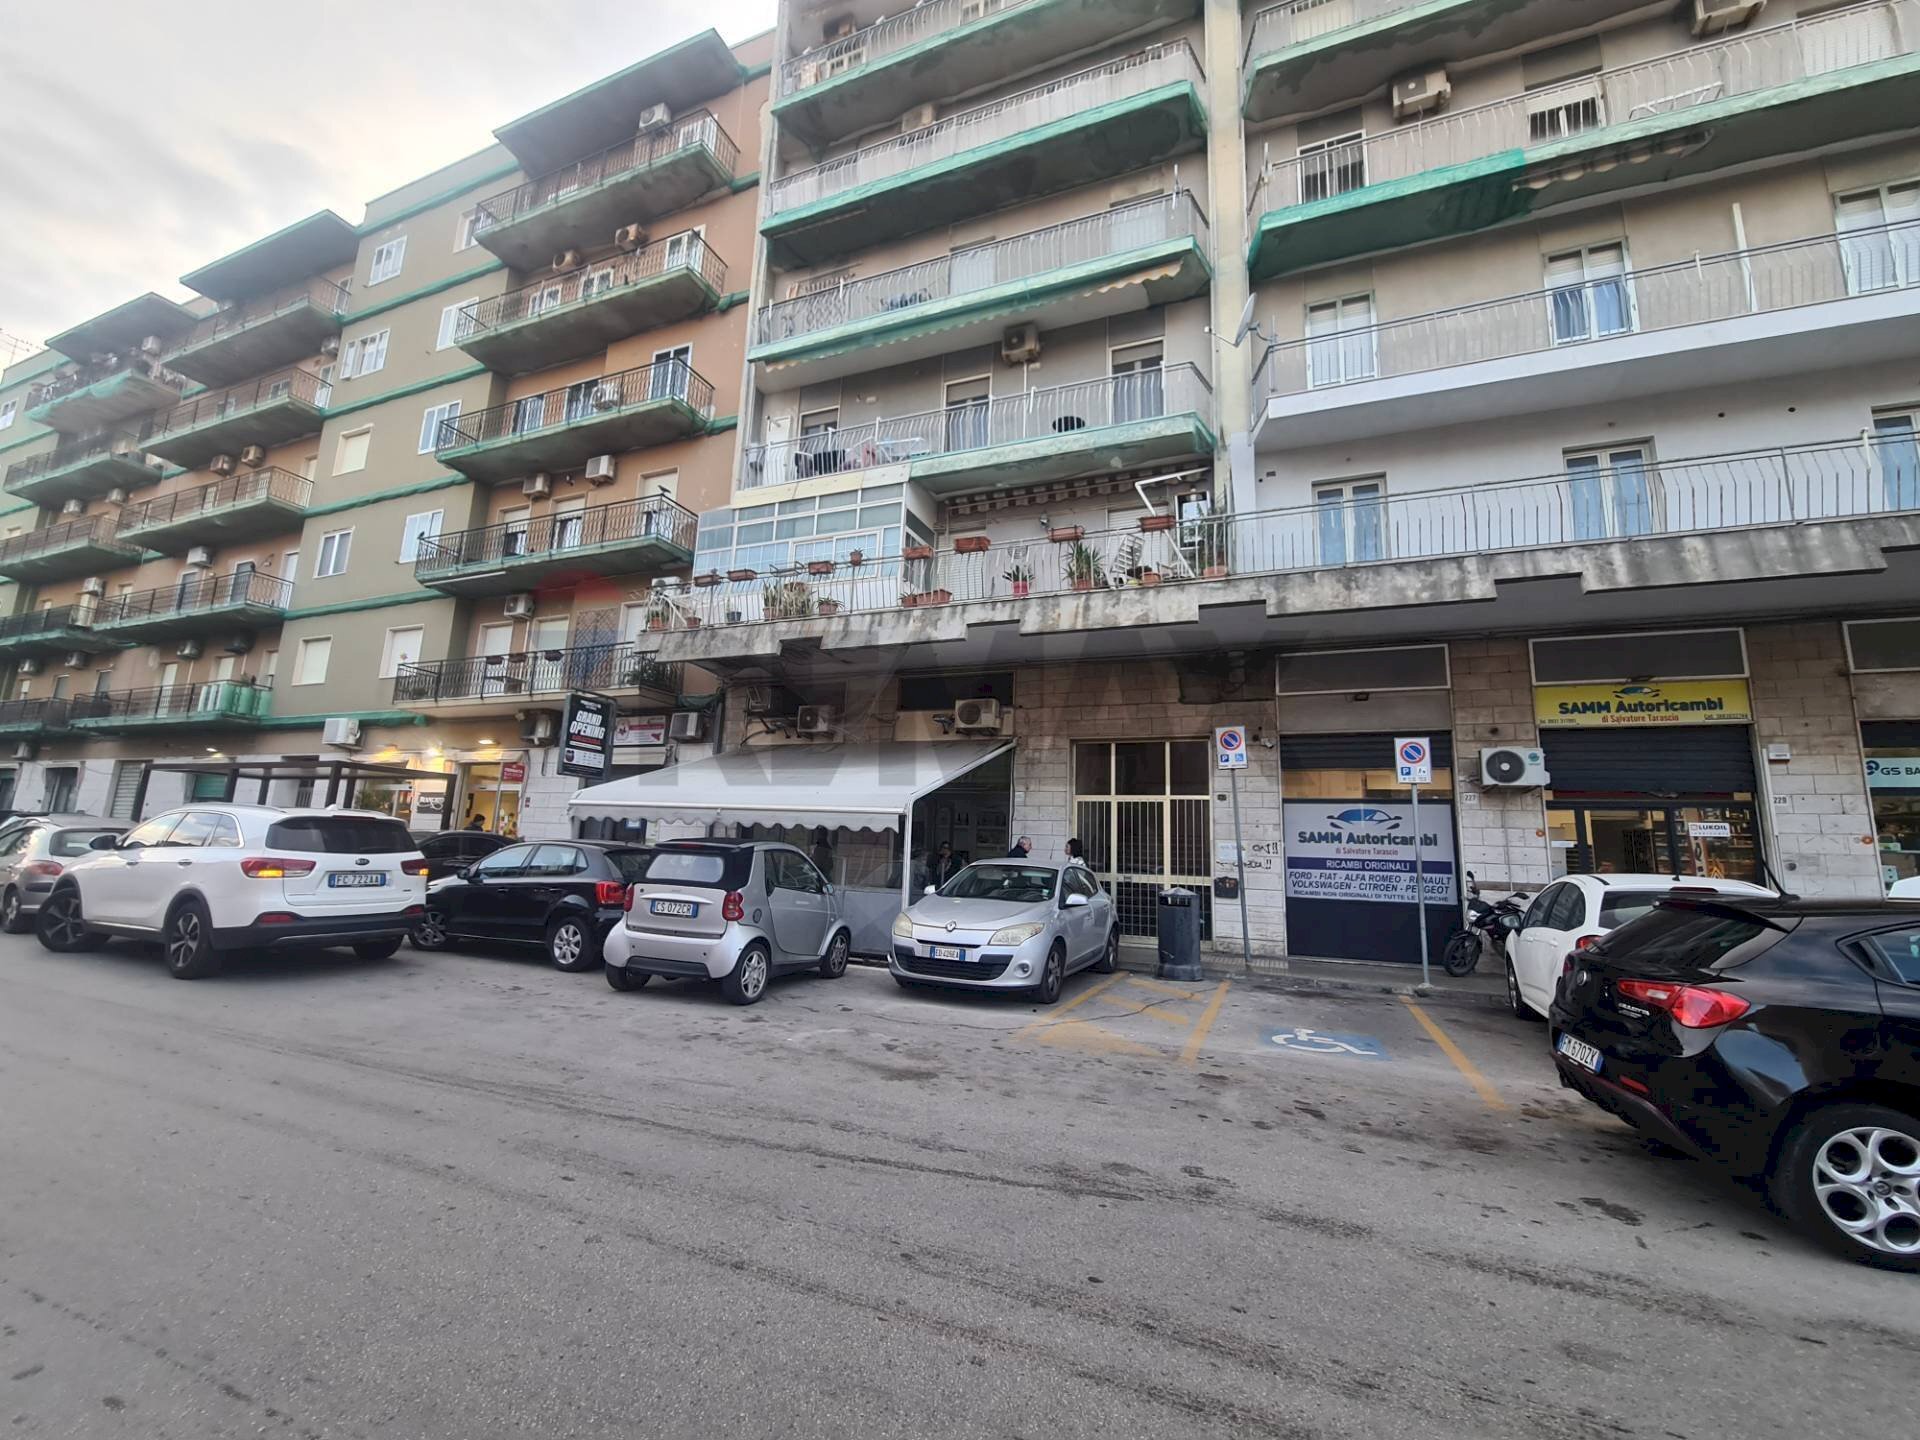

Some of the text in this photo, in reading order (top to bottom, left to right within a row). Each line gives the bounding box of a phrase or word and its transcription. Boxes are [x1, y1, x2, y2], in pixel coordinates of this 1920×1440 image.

[1558, 698, 1723, 715] SAMM Autoricambi
[576, 711, 602, 726] GRAND
[1601, 715, 1609, 724] di
[1610, 714, 1646, 724] Salvatore
[570, 721, 606, 739] OPENING
[1880, 767, 1902, 776] GS
[1298, 831, 1343, 844] SAMM
[1342, 847, 1372, 856] Salvatore
[1326, 859, 1410, 871] RICAMBI ORIGINALI
[336, 875, 379, 884] FC 722AA
[1289, 871, 1452, 886] FORD FIAT ALFA ROMEO RNAULT
[1292, 880, 1450, 895] VOLKSWAGEN CITROEN PEGEOT
[1338, 891, 1374, 899] ORIGINALI
[1383, 893, 1404, 901] TUTTE
[1423, 895, 1449, 903] ARCHE
[656, 902, 666, 912] CS
